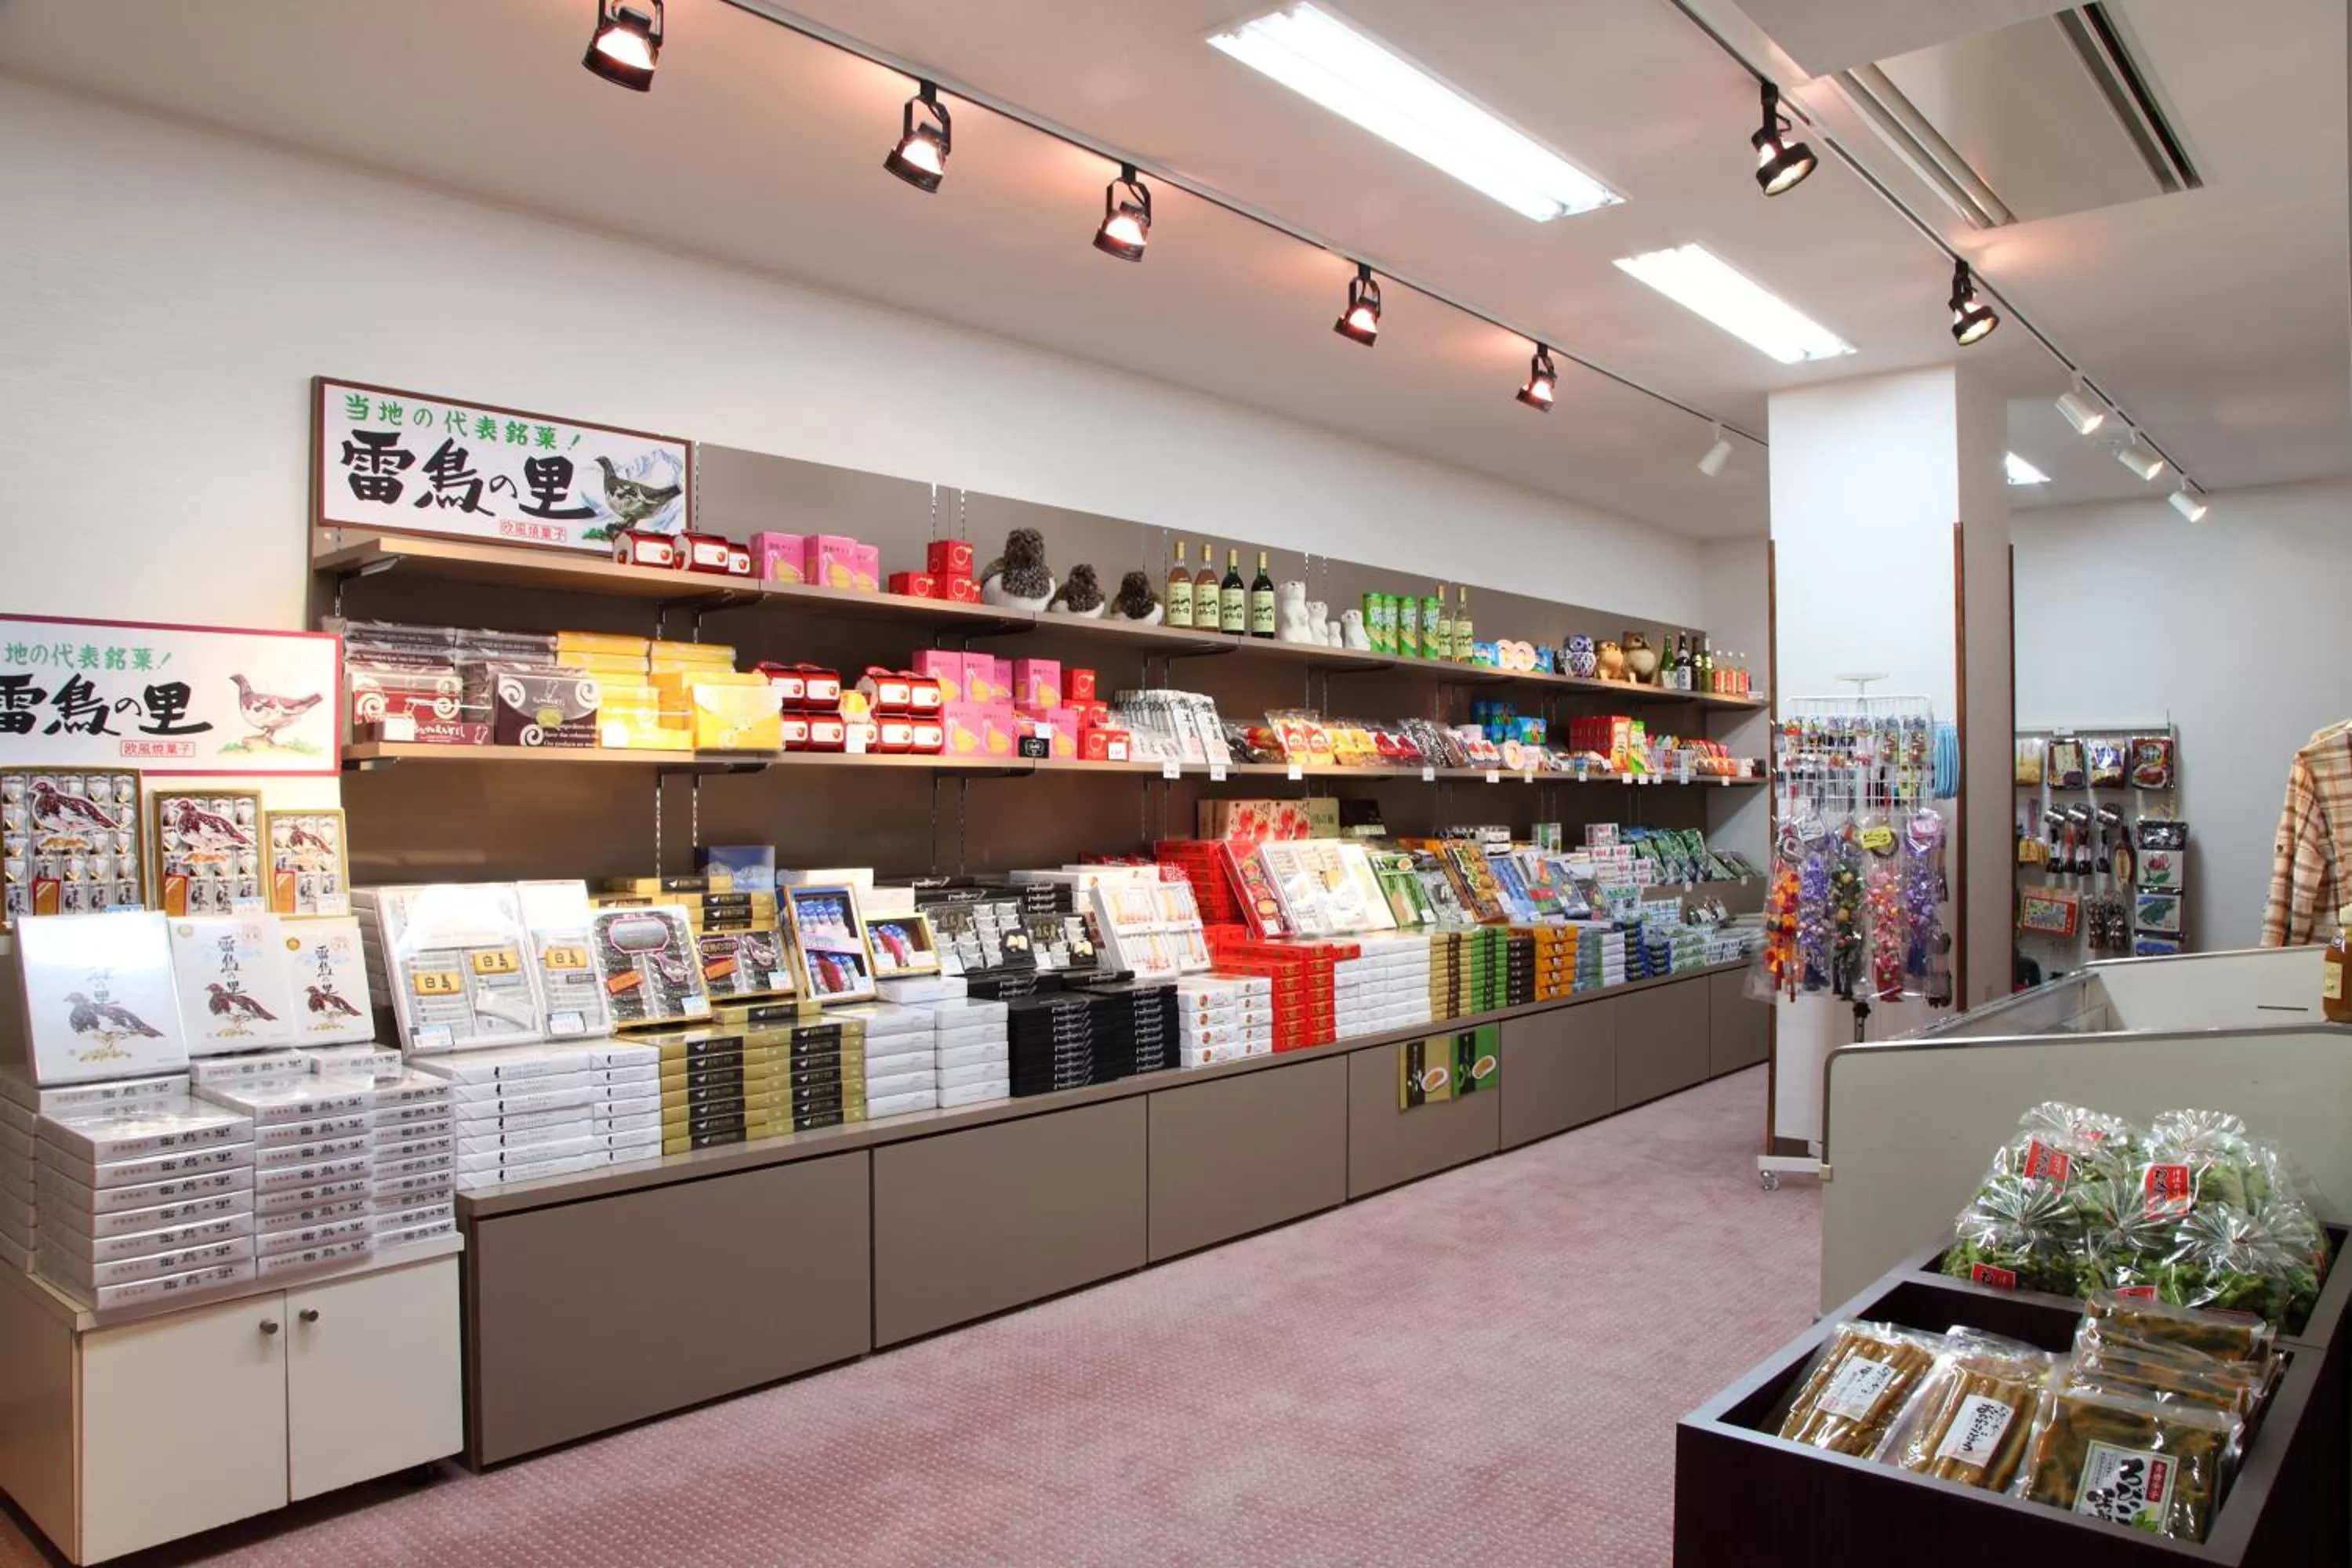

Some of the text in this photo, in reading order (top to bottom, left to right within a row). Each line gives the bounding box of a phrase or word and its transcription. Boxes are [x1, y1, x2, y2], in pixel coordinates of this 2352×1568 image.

[344, 394, 582, 451] 当地の代表銘菓!
[339, 428, 598, 519] 雷鳥の里
